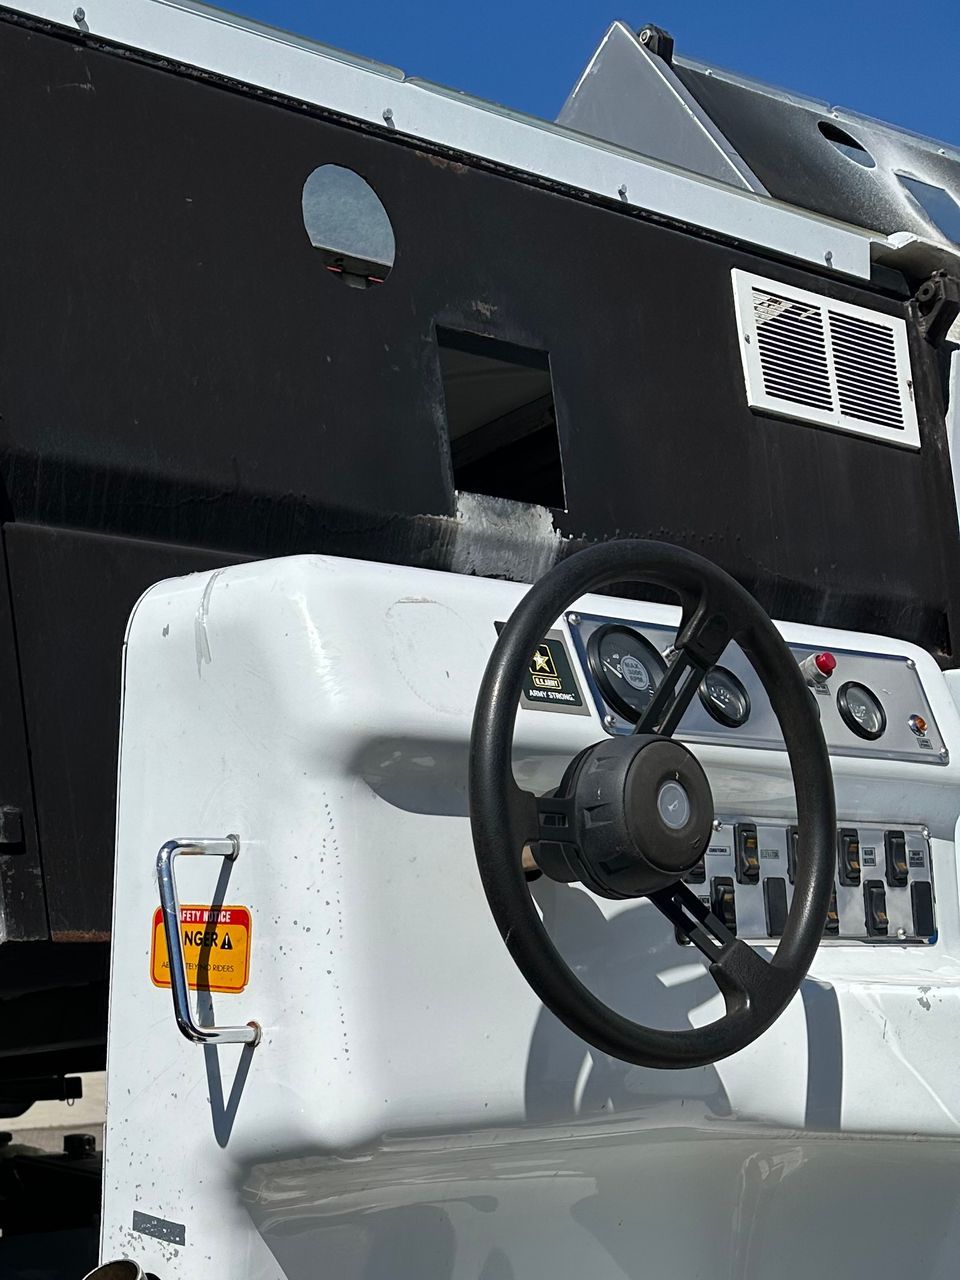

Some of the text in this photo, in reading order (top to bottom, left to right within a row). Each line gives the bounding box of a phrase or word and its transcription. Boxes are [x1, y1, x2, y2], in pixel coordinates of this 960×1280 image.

[529, 689, 547, 698] ARMY
[180, 910, 231, 923] FETY NOTICE
[183, 930, 219, 947] NGER
[212, 964, 234, 973] RIDERS
